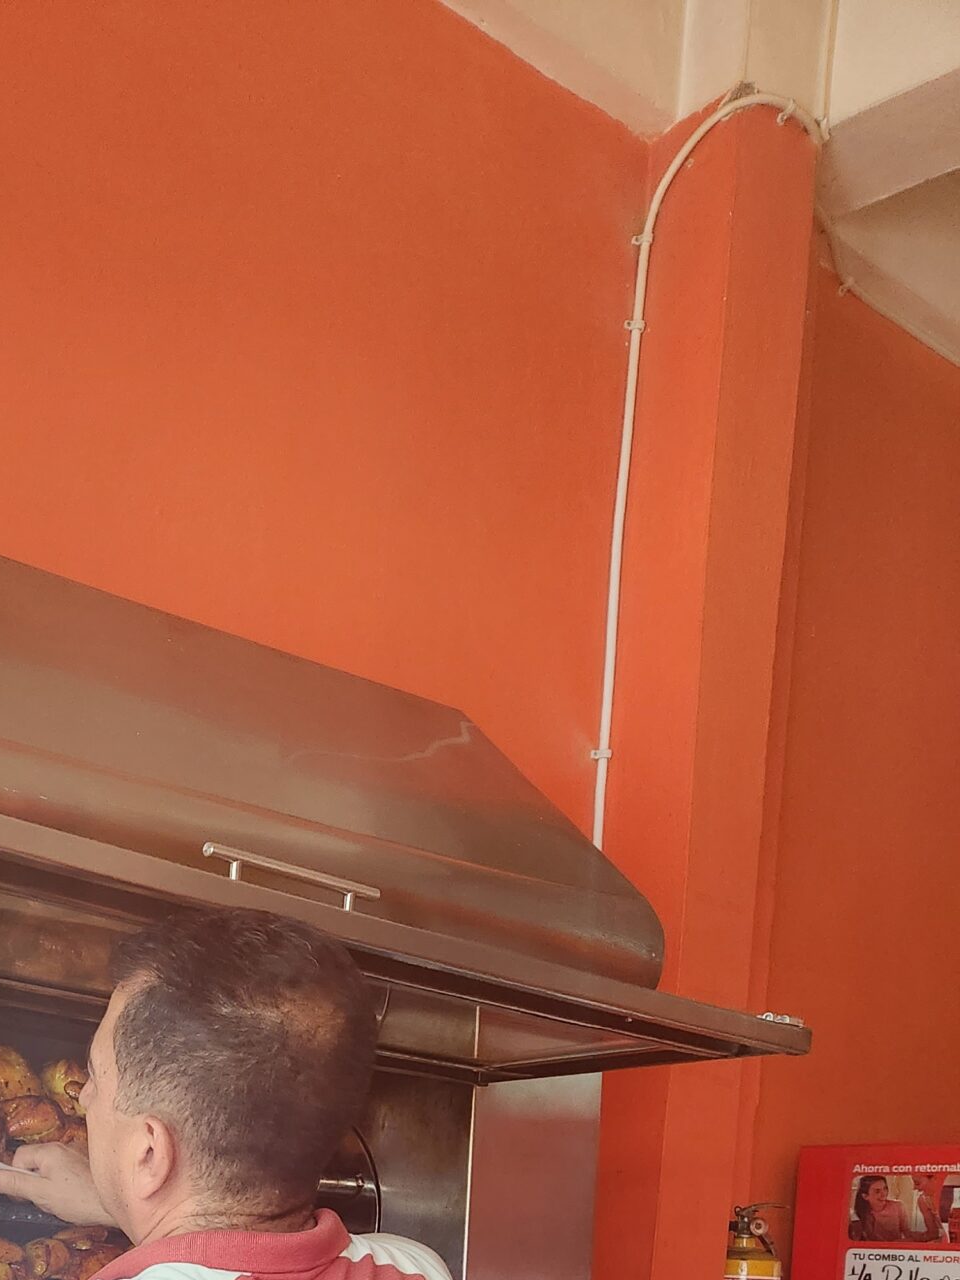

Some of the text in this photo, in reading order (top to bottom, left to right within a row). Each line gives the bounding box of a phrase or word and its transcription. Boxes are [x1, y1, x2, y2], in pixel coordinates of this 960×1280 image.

[853, 1164, 890, 1173] Ahorra
[892, 1164, 912, 1173] con
[852, 1253, 866, 1261] TU
[868, 1253, 905, 1261] COMBO
